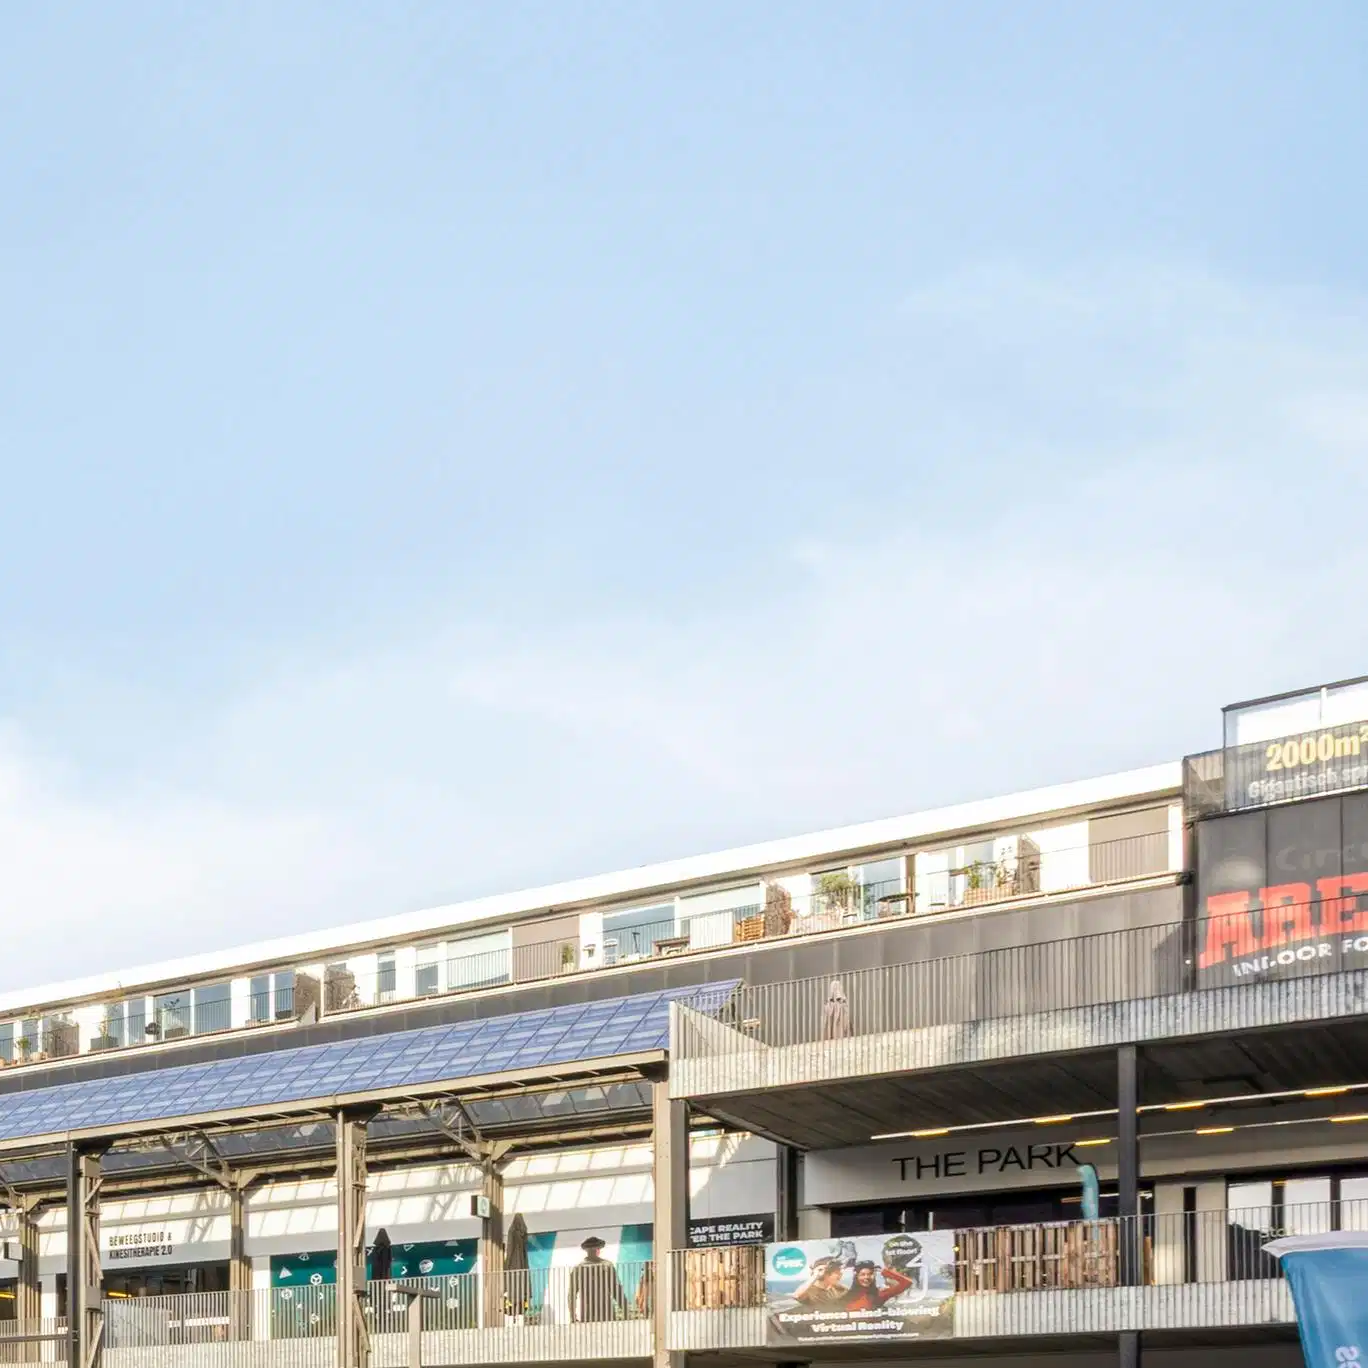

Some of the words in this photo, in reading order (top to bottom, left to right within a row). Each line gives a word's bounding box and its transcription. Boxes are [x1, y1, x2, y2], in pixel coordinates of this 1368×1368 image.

[892, 1152, 966, 1181] THE
[978, 1144, 1082, 1174] PARK
[709, 1232, 730, 1241] THE
[733, 1229, 763, 1239] PARK
[718, 1222, 763, 1233] REALITY
[108, 1231, 164, 1247] BEWEEGSTUDIO
[109, 1245, 159, 1260] KINESITHERAPIE
[161, 1244, 172, 1256] 2.0
[779, 1311, 848, 1323] Experience
[849, 1306, 941, 1320] mind-blowing
[811, 1321, 856, 1333] Virtual
[858, 1319, 904, 1331] Reality
